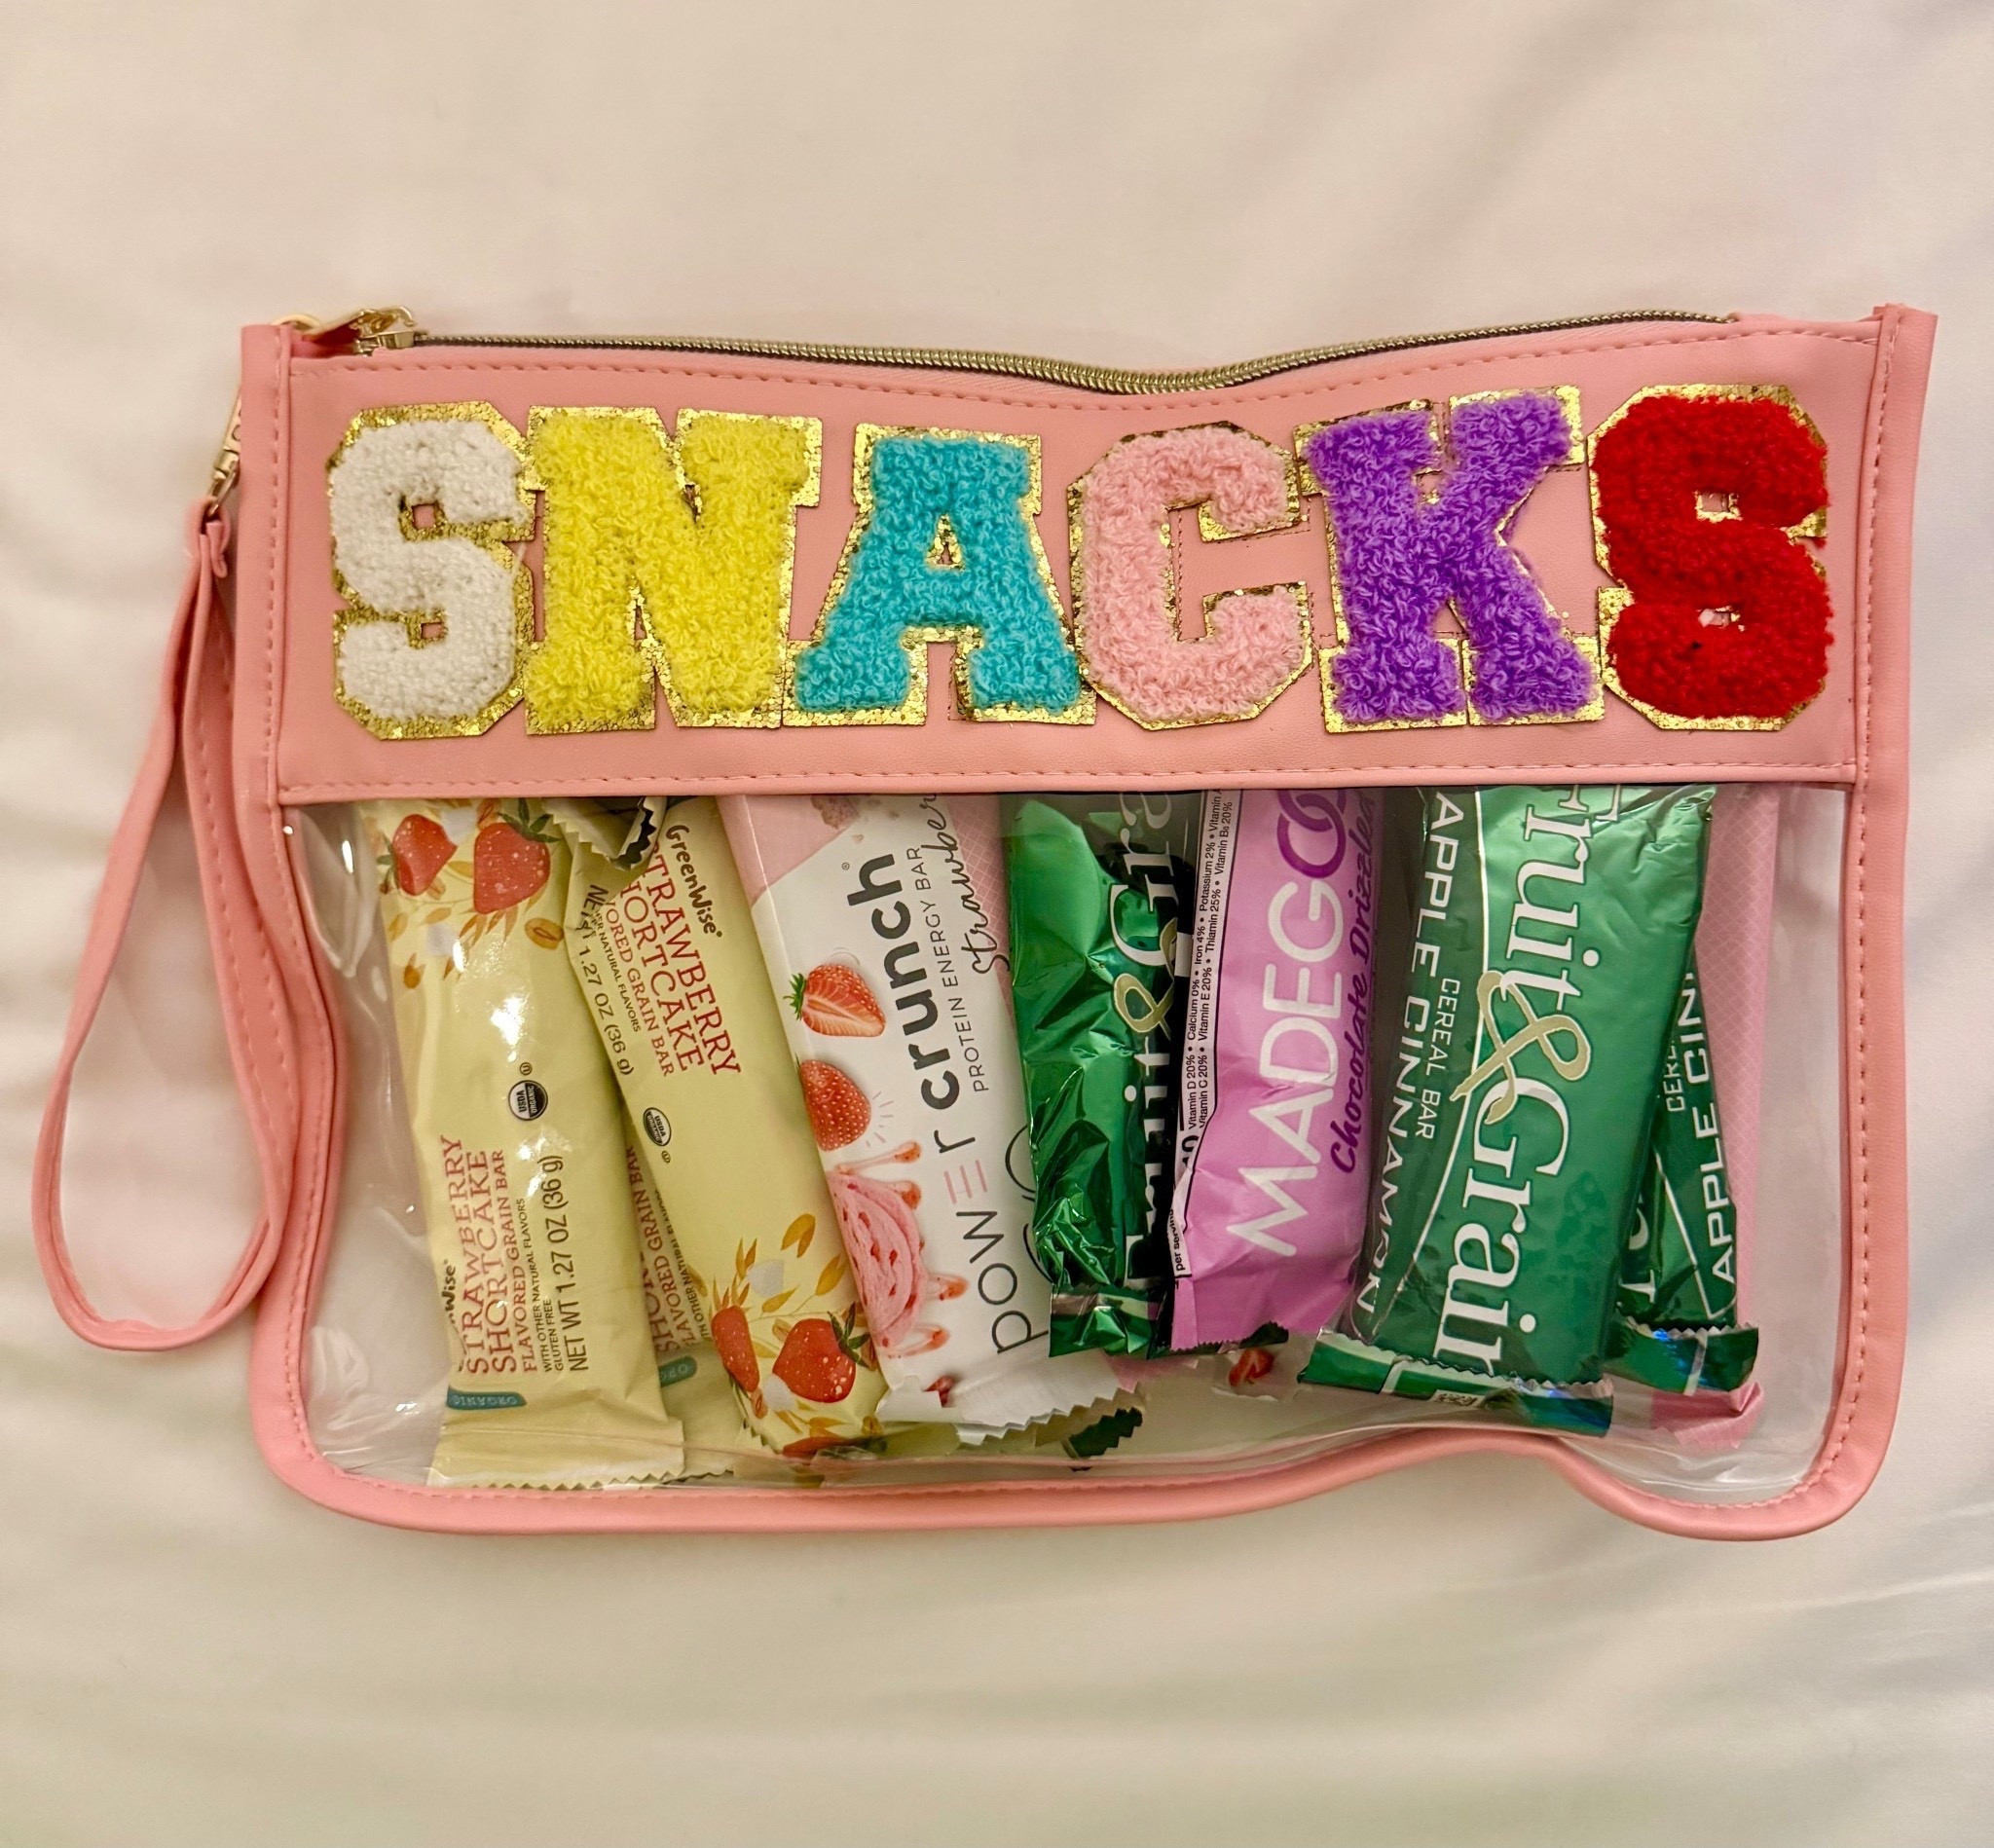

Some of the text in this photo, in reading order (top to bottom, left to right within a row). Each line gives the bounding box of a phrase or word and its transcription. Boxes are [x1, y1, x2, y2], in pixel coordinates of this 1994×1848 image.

[329, 384, 1831, 739] SNACKS
[1208, 796, 1221, 832] Vitamin
[1222, 801, 1233, 825] 20%
[1205, 842, 1216, 862] 2%
[1215, 840, 1229, 875] Vitamin
[666, 825, 718, 935] GreenWise
[1200, 863, 1213, 912] Potassium
[1210, 888, 1221, 912] 25%
[1197, 926, 1206, 942] 4%
[1205, 913, 1219, 953] Thiamin
[906, 847, 989, 1092] PROTEIN ENERGY BAR
[1195, 943, 1203, 965] Iron
[599, 932, 622, 981] NATURAL
[617, 982, 642, 1033] FLAVORS
[847, 853, 960, 1110] crunch
[1191, 979, 1200, 997] 0%
[1201, 967, 1212, 991] 20%
[579, 945, 603, 985] 1.27
[594, 992, 614, 1019] OZ
[604, 1024, 626, 1053] (36
[616, 1058, 635, 1076] g)
[627, 967, 659, 1032] GRAIN
[651, 1035, 675, 1077] BAR
[1187, 999, 1198, 1041] Calcium
[1198, 1003, 1210, 1042] Vitamin
[1185, 1054, 1196, 1079] 20%
[1198, 1054, 1208, 1078] 20%
[1330, 972, 1369, 1174] Chocolate
[1356, 792, 1464, 1313] APPLE CINNAMON
[1415, 978, 1460, 1139] CEREAL BAR
[516, 1090, 528, 1113] USDA
[1187, 1081, 1197, 1090] D
[1199, 1080, 1208, 1090] C
[1188, 1089, 1198, 1129] Vitamin
[1199, 1090, 1208, 1128] Vitamin
[1691, 1102, 1736, 1285] APPLE
[633, 1189, 663, 1251] GRAIN
[440, 1134, 489, 1374] STRAWBERRY
[466, 1151, 517, 1373] SHORTCAKE
[492, 1150, 537, 1372] FLAVORED GRAIN BAR
[537, 1155, 589, 1372] NET WT 1.27 OZ (36 g)
[1176, 1252, 1186, 1272] per
[516, 1198, 553, 1372] WITH OTHER NATURAL FLAVORS
[685, 1287, 705, 1320] OTHER
[543, 1299, 564, 1371] GLUTEN FREE
